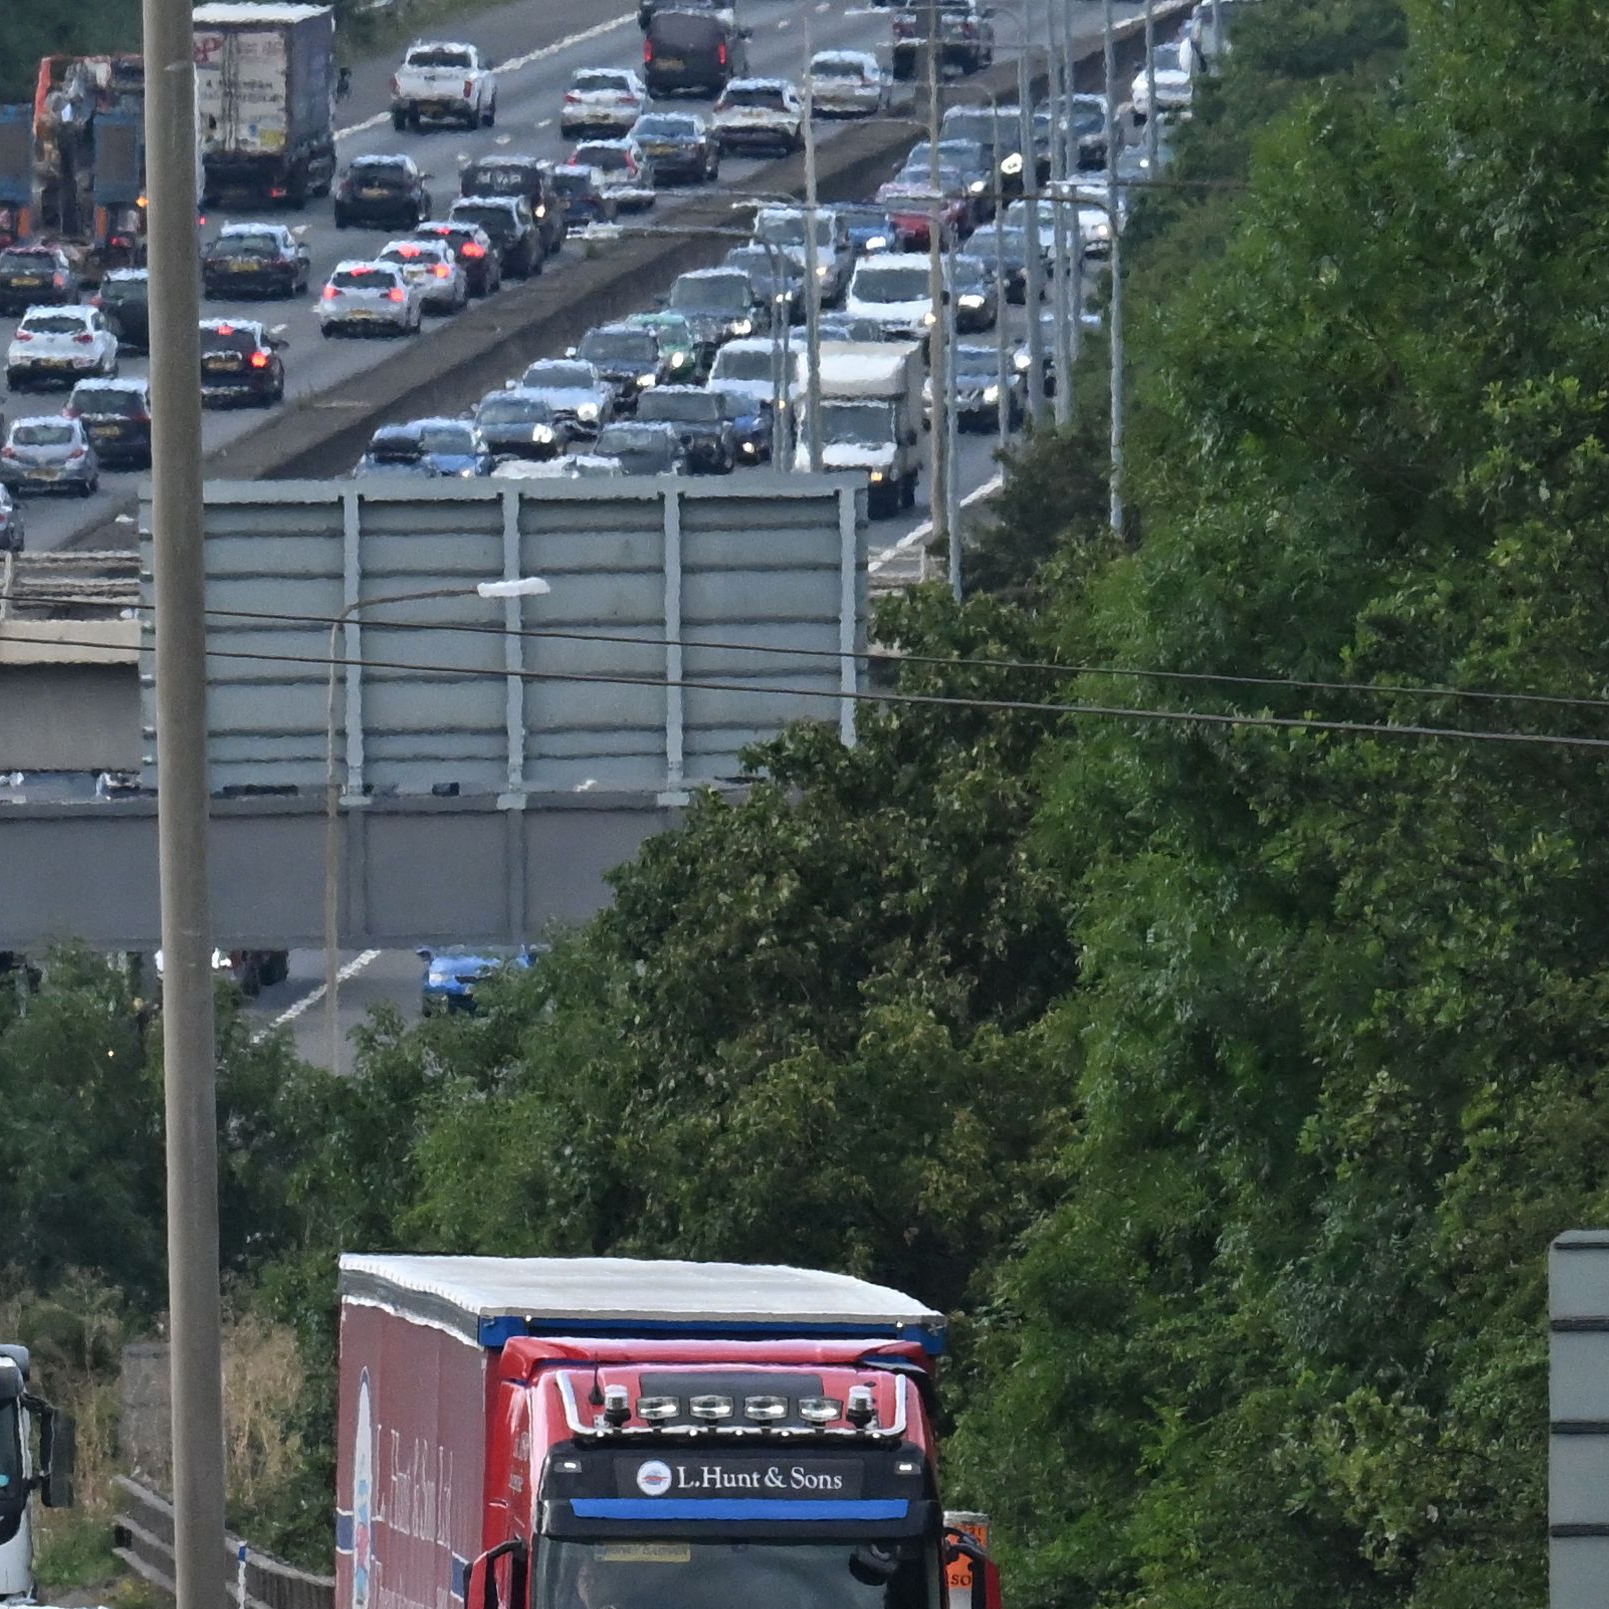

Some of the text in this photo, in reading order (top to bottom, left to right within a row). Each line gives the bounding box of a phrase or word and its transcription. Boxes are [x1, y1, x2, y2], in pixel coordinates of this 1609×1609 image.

[677, 1465, 843, 1490] L.Hunt & Sons
